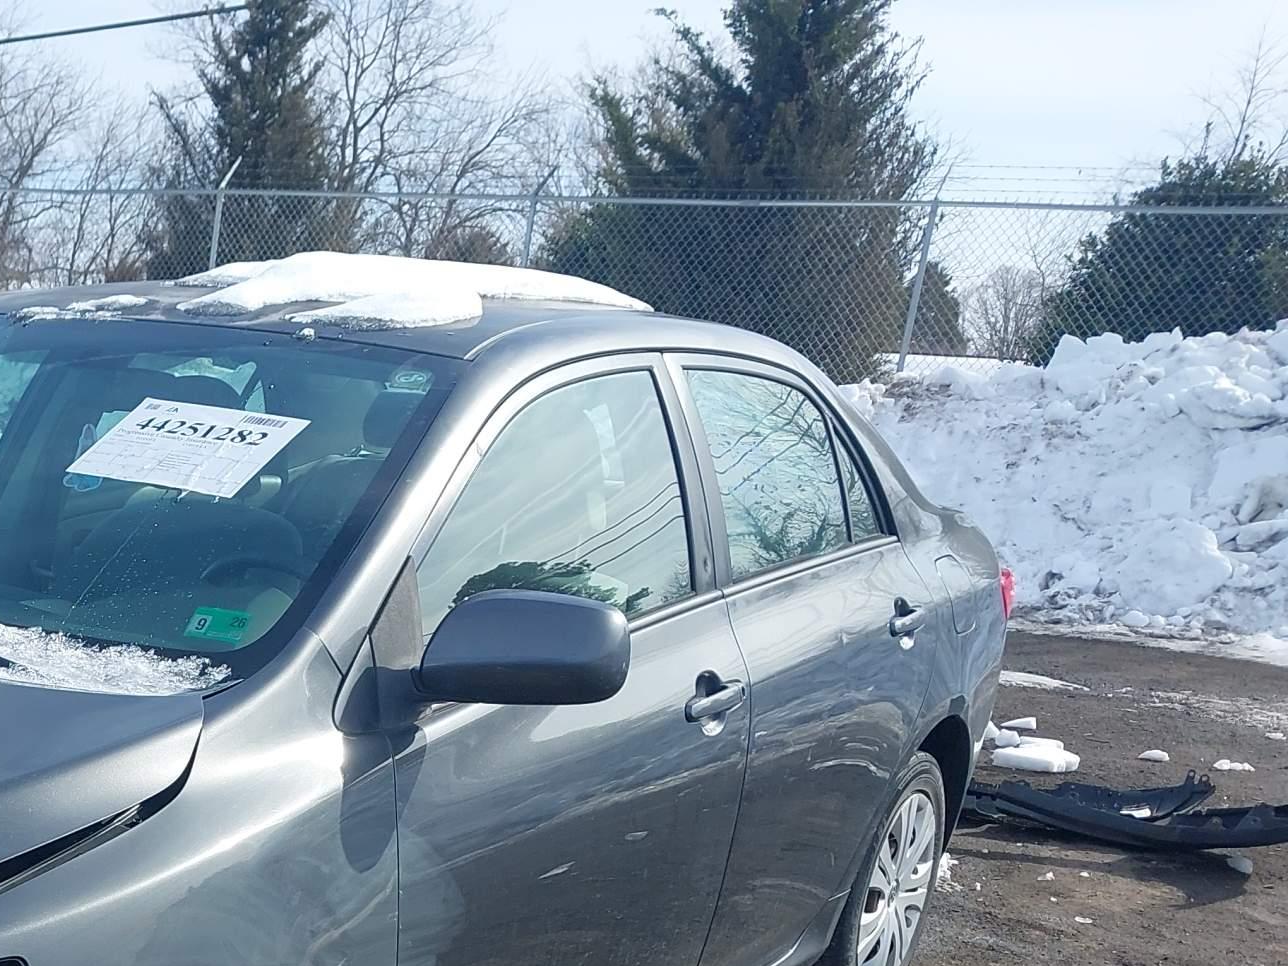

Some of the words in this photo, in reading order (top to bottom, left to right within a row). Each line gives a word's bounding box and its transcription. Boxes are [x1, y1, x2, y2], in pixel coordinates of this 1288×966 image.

[136, 416, 269, 446] 44251282
[195, 617, 207, 631] 9
[230, 616, 248, 629] 26
